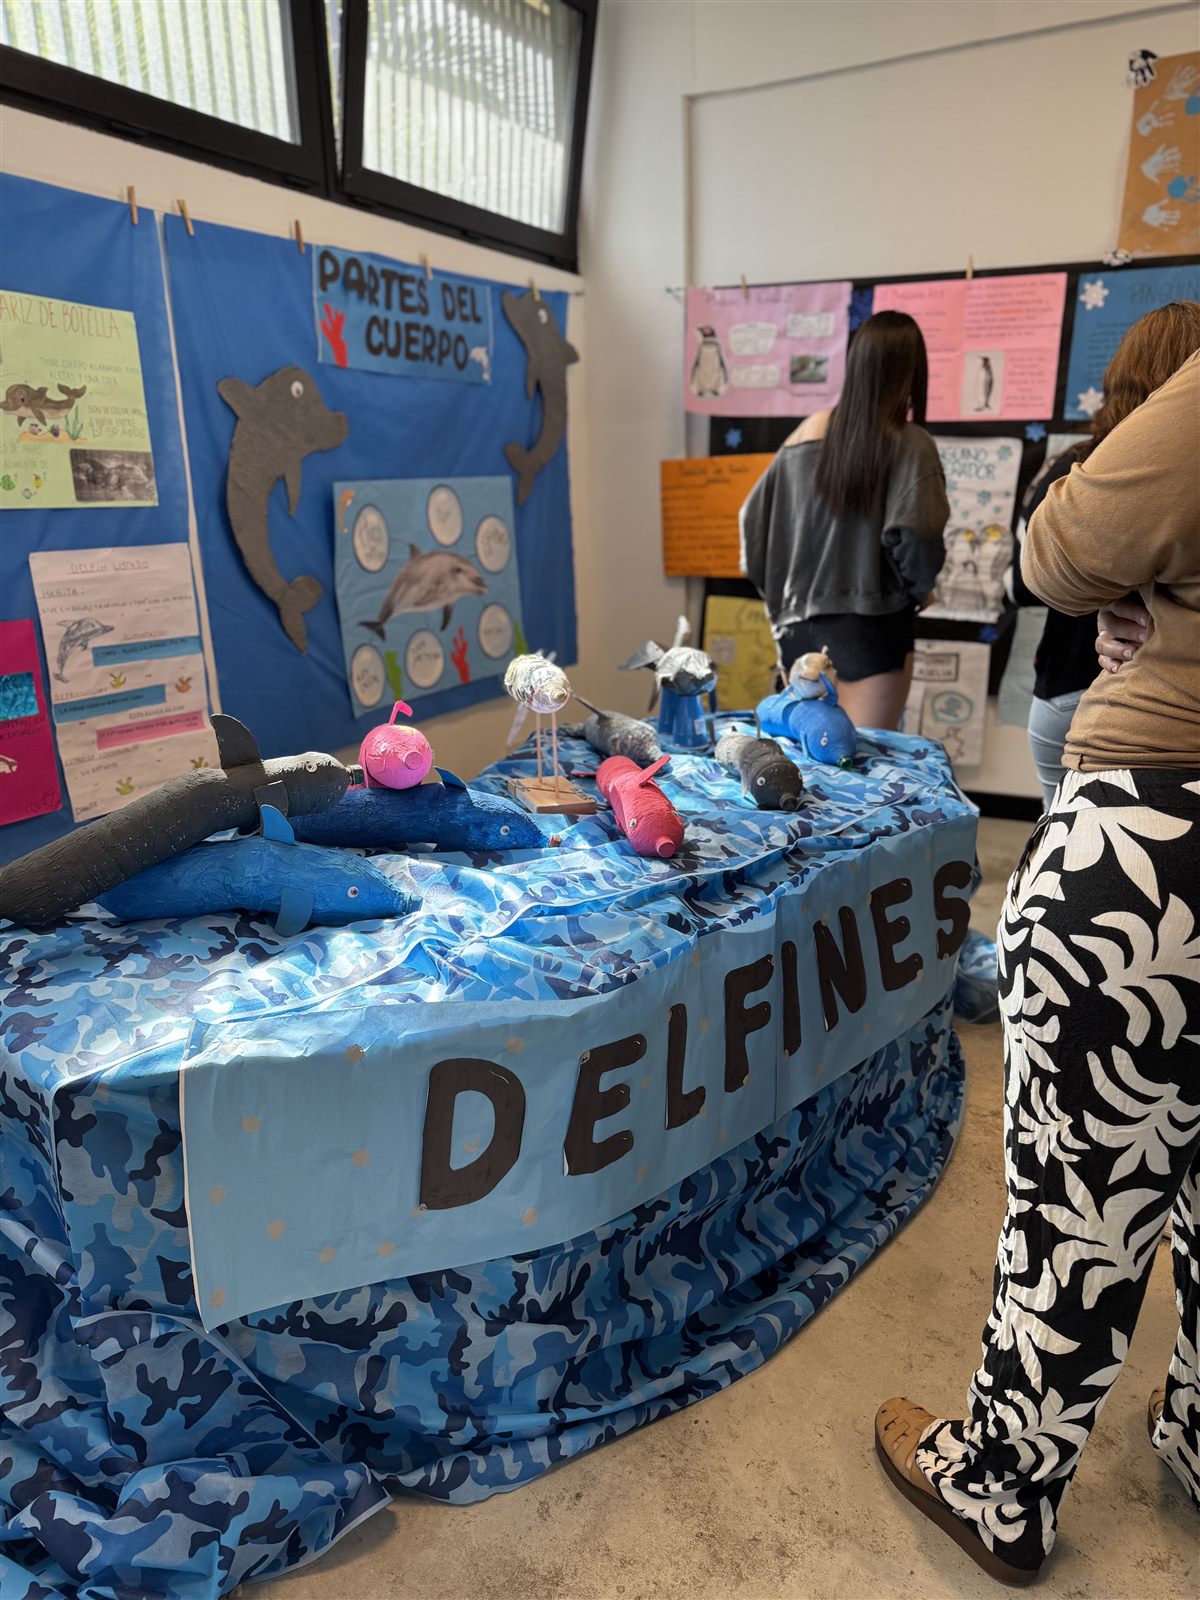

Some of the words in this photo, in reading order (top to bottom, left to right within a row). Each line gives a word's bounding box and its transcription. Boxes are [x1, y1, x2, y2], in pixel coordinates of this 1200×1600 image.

[319, 250, 429, 317] PARTES
[440, 282, 482, 325] DEL
[38, 301, 58, 328] DE
[62, 304, 122, 340] BOTELLA
[365, 315, 468, 371] CUERPO
[418, 860, 974, 1211] DELFINES
